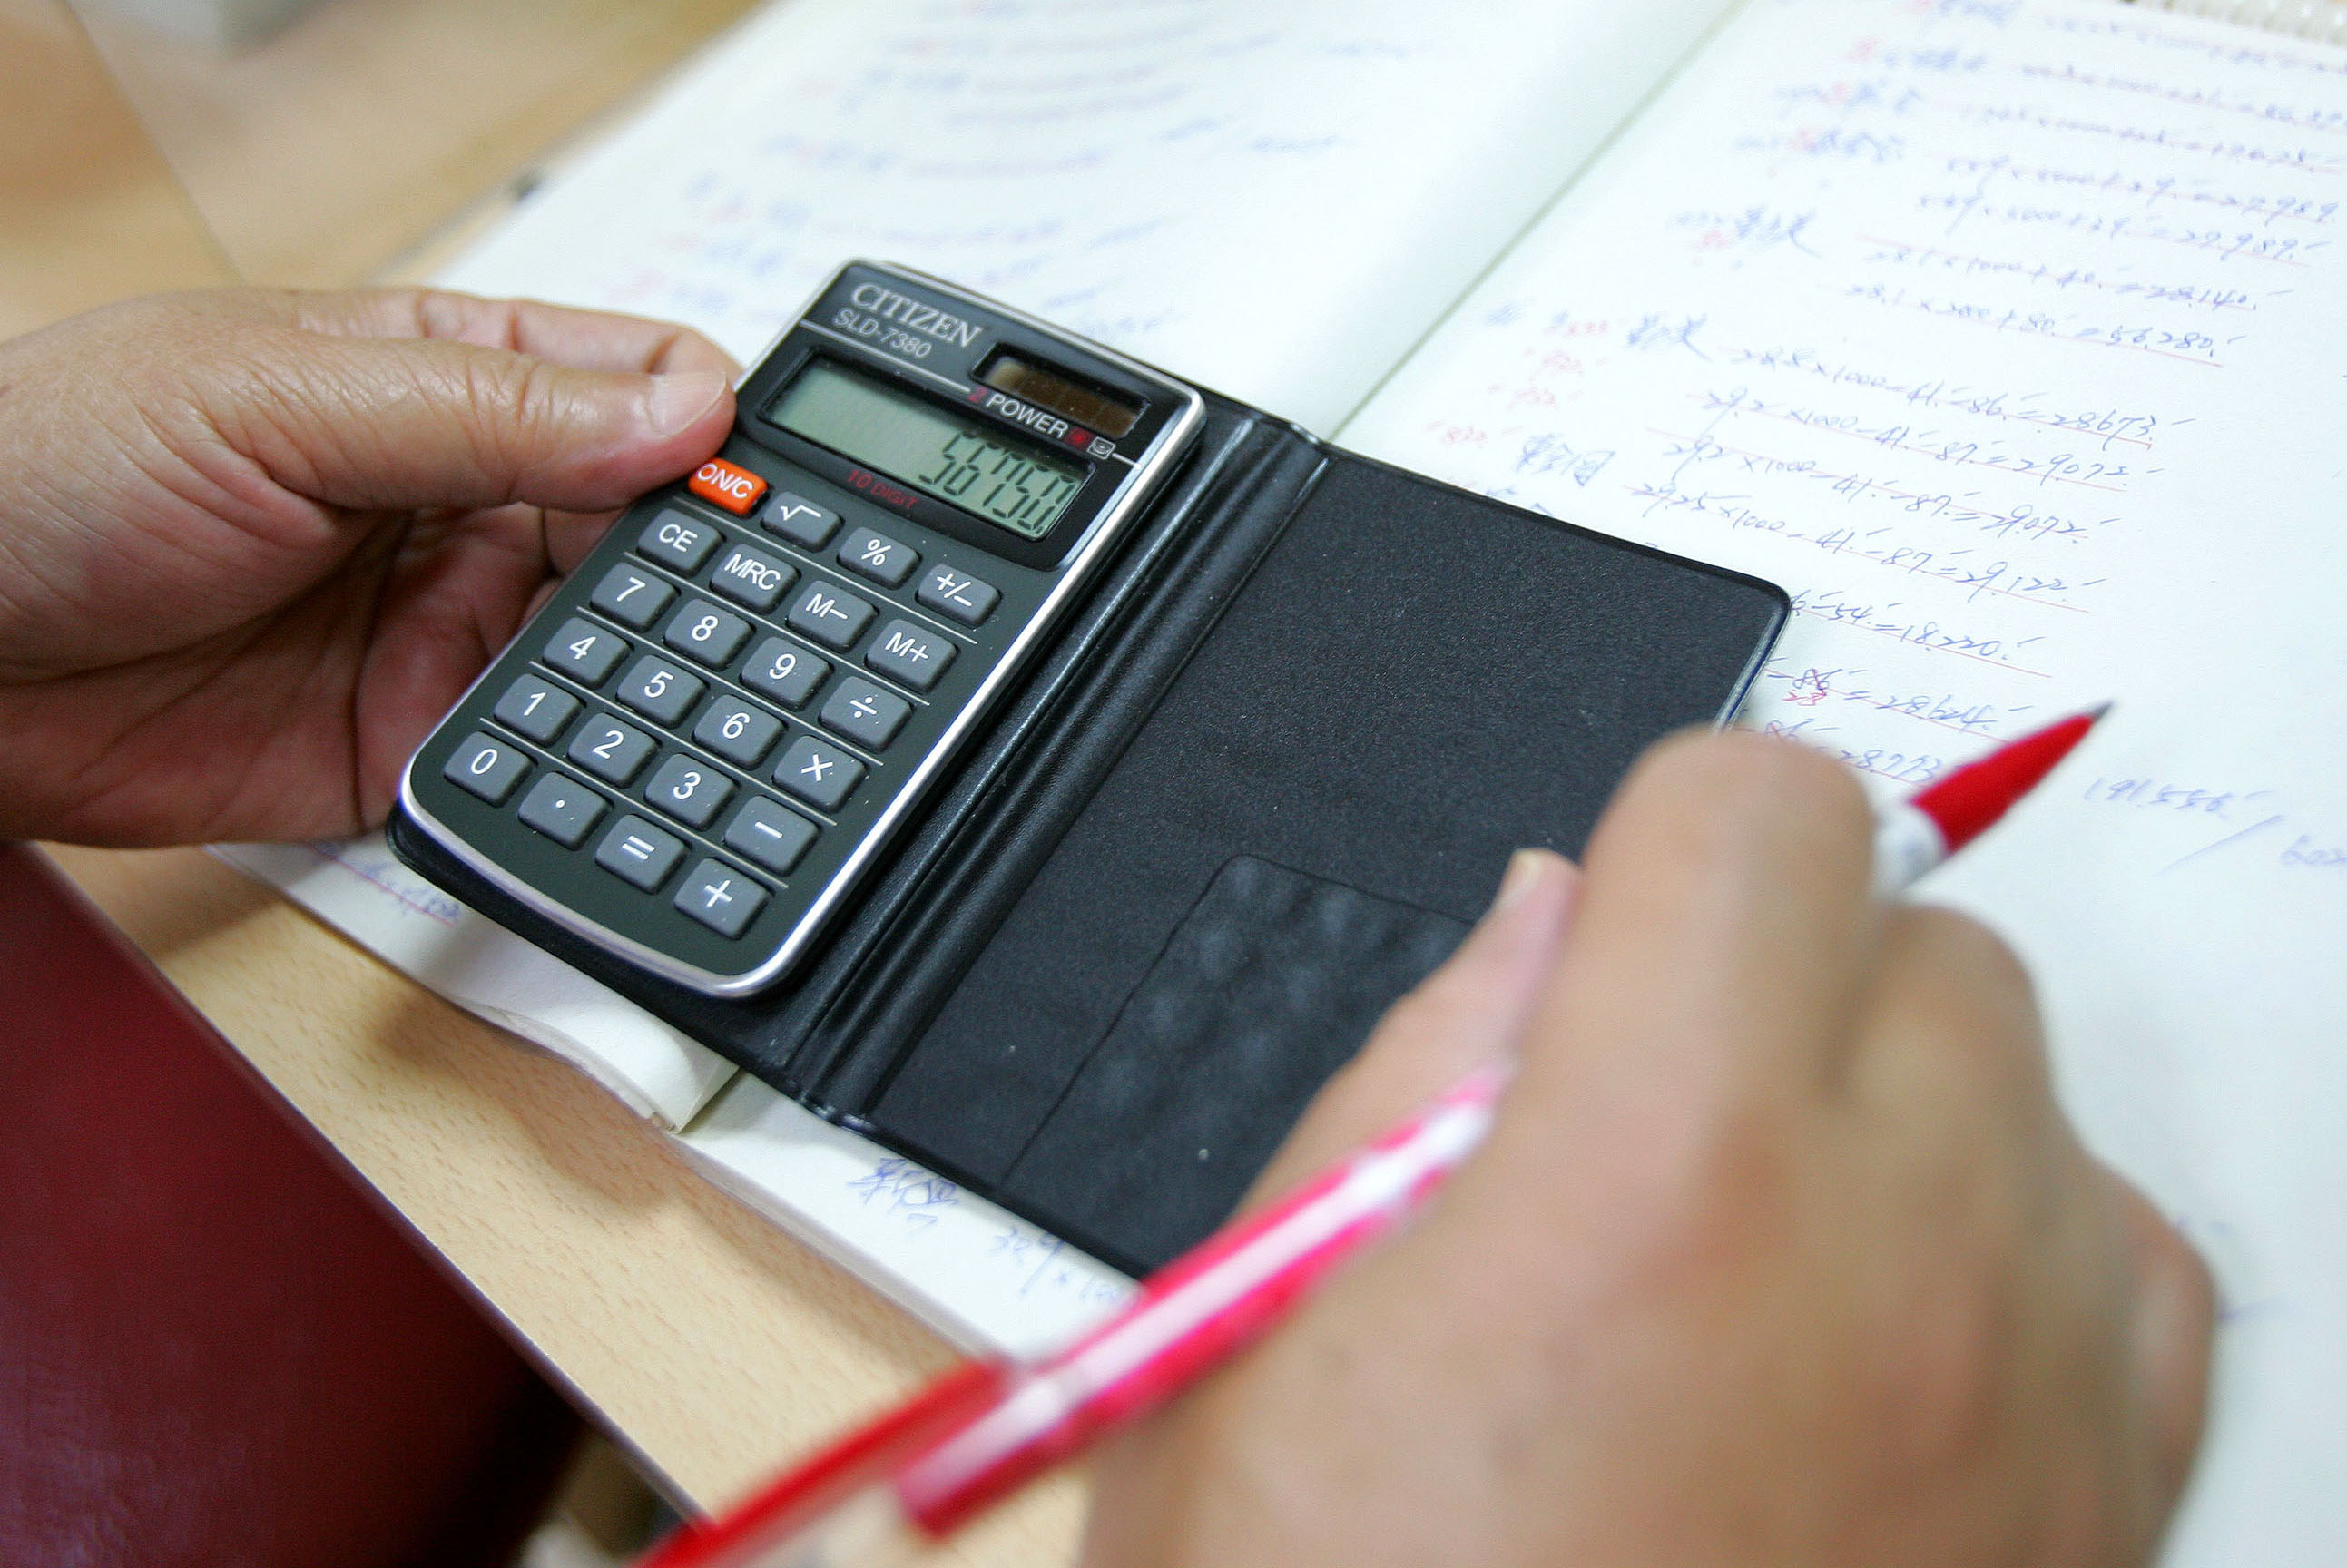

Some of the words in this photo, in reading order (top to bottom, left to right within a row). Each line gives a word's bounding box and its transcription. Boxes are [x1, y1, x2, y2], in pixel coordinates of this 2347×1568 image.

[851, 283, 981, 348] CITIZEN
[833, 309, 933, 358] SLD-7380
[987, 393, 1069, 439] POWER
[697, 463, 753, 499] ON/C
[869, 483, 918, 509] DIGIT
[659, 524, 698, 553] CE
[723, 553, 781, 591] MRC
[616, 576, 646, 602] 7
[691, 615, 719, 642] 8
[569, 636, 597, 660] 4
[885, 632, 928, 662] M+
[769, 653, 797, 680] 9
[643, 671, 674, 698] 5
[523, 691, 546, 716] 1
[722, 712, 751, 740] 6
[592, 730, 624, 760] 2
[470, 748, 498, 775] 0
[673, 771, 702, 799] 3
